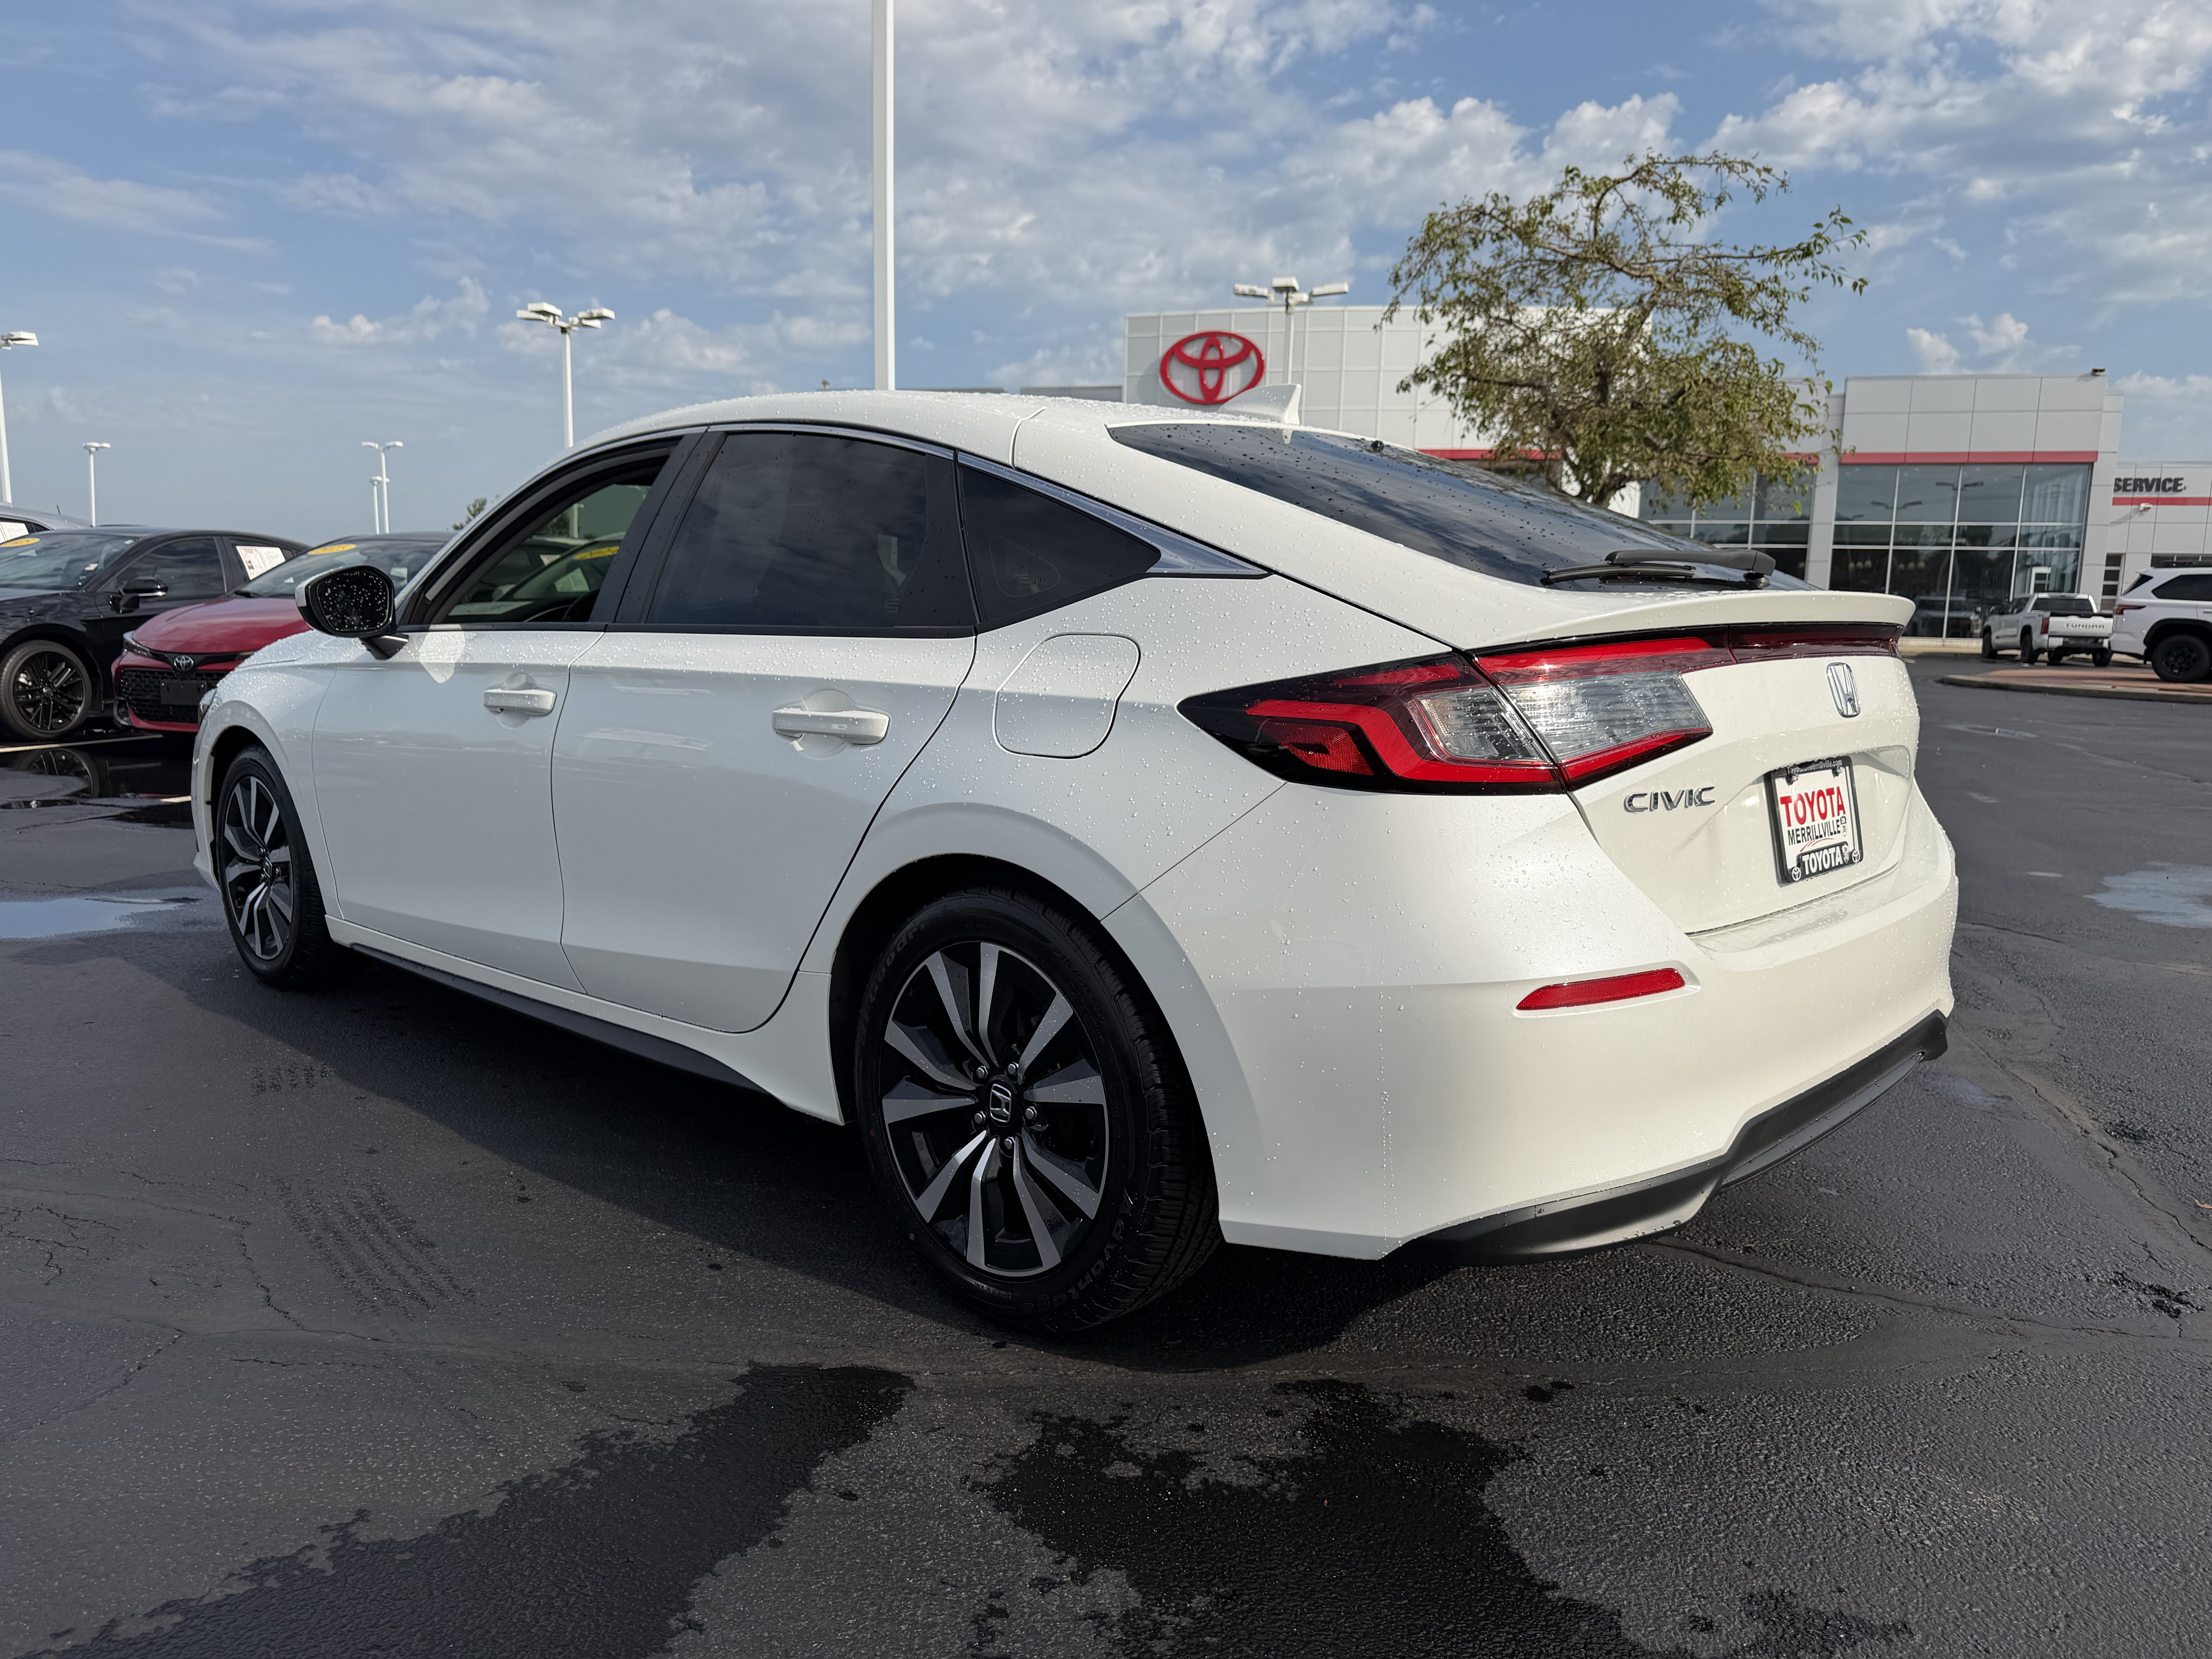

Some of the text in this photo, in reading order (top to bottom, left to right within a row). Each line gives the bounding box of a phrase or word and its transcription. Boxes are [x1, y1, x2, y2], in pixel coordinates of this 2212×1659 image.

[2113, 477, 2184, 493] SERVICE
[1624, 787, 1715, 812] CIVIC
[1780, 787, 1846, 827] TOYOTA
[1787, 819, 1841, 845] MERRILLVILLE
[1802, 846, 1843, 875] TOYOTA
